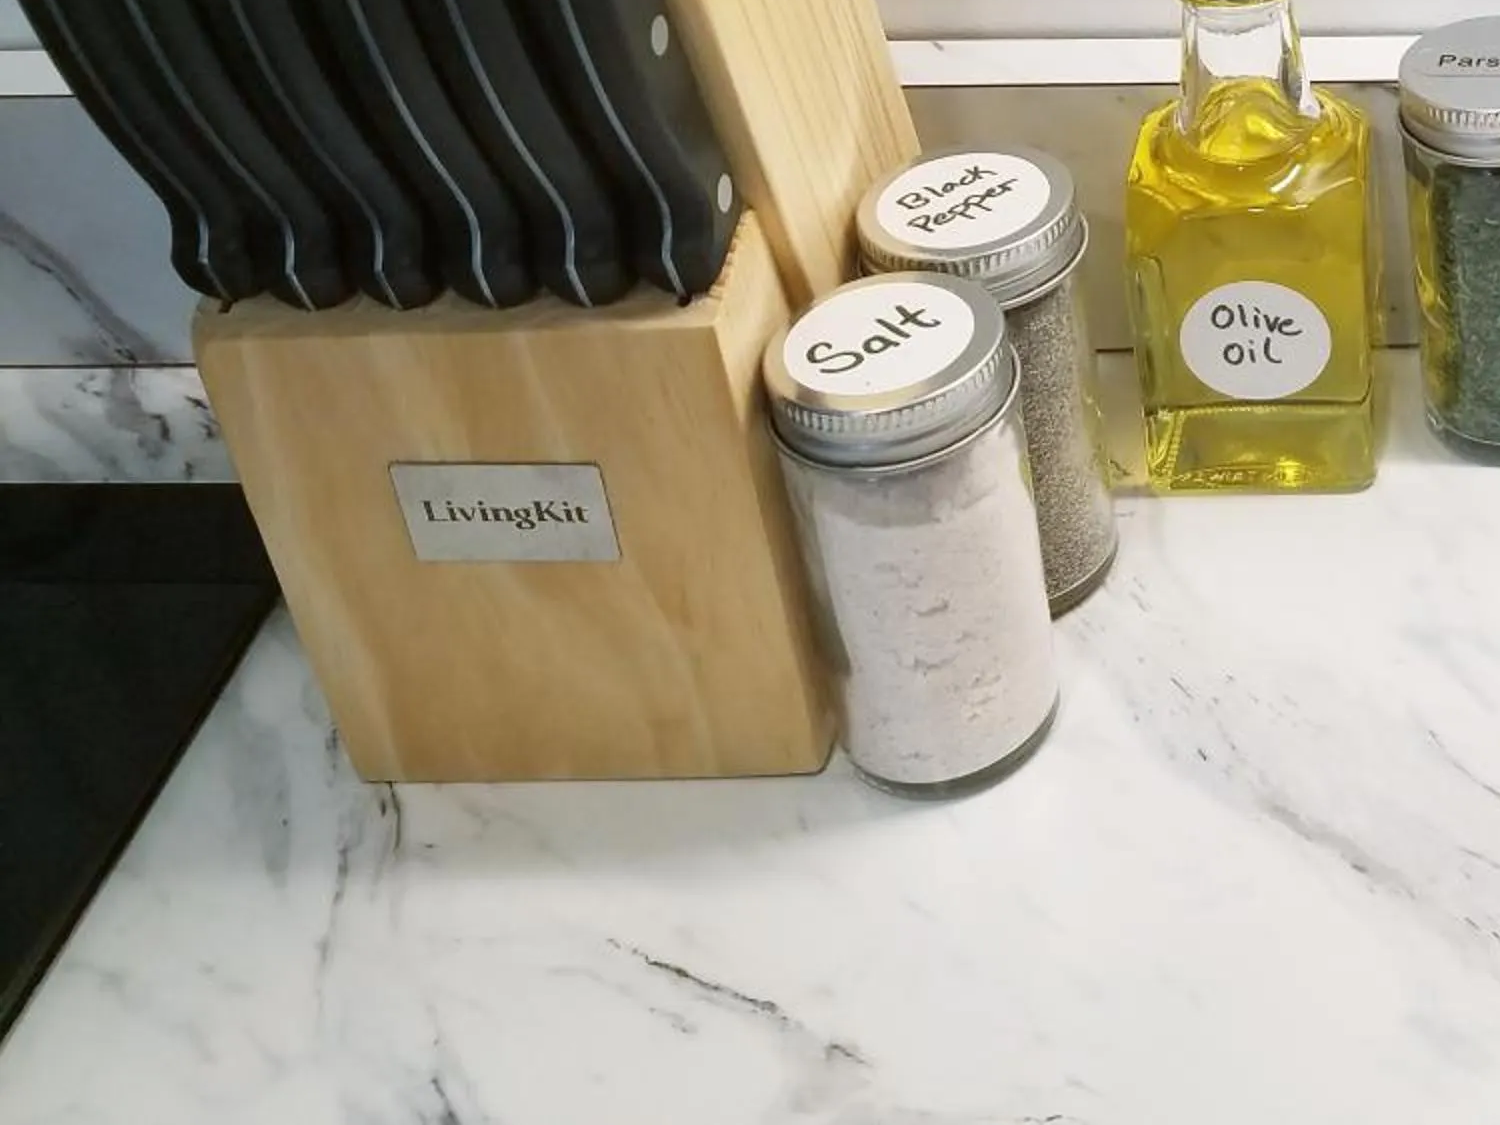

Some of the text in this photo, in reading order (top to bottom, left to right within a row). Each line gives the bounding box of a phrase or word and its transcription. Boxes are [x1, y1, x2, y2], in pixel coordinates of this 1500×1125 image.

[896, 165, 998, 210] Black
[907, 178, 1019, 233] Pepper
[1211, 304, 1302, 336] Olive
[806, 305, 942, 374] Salt
[1223, 337, 1282, 365] Oil
[421, 500, 590, 530] LivingKit
